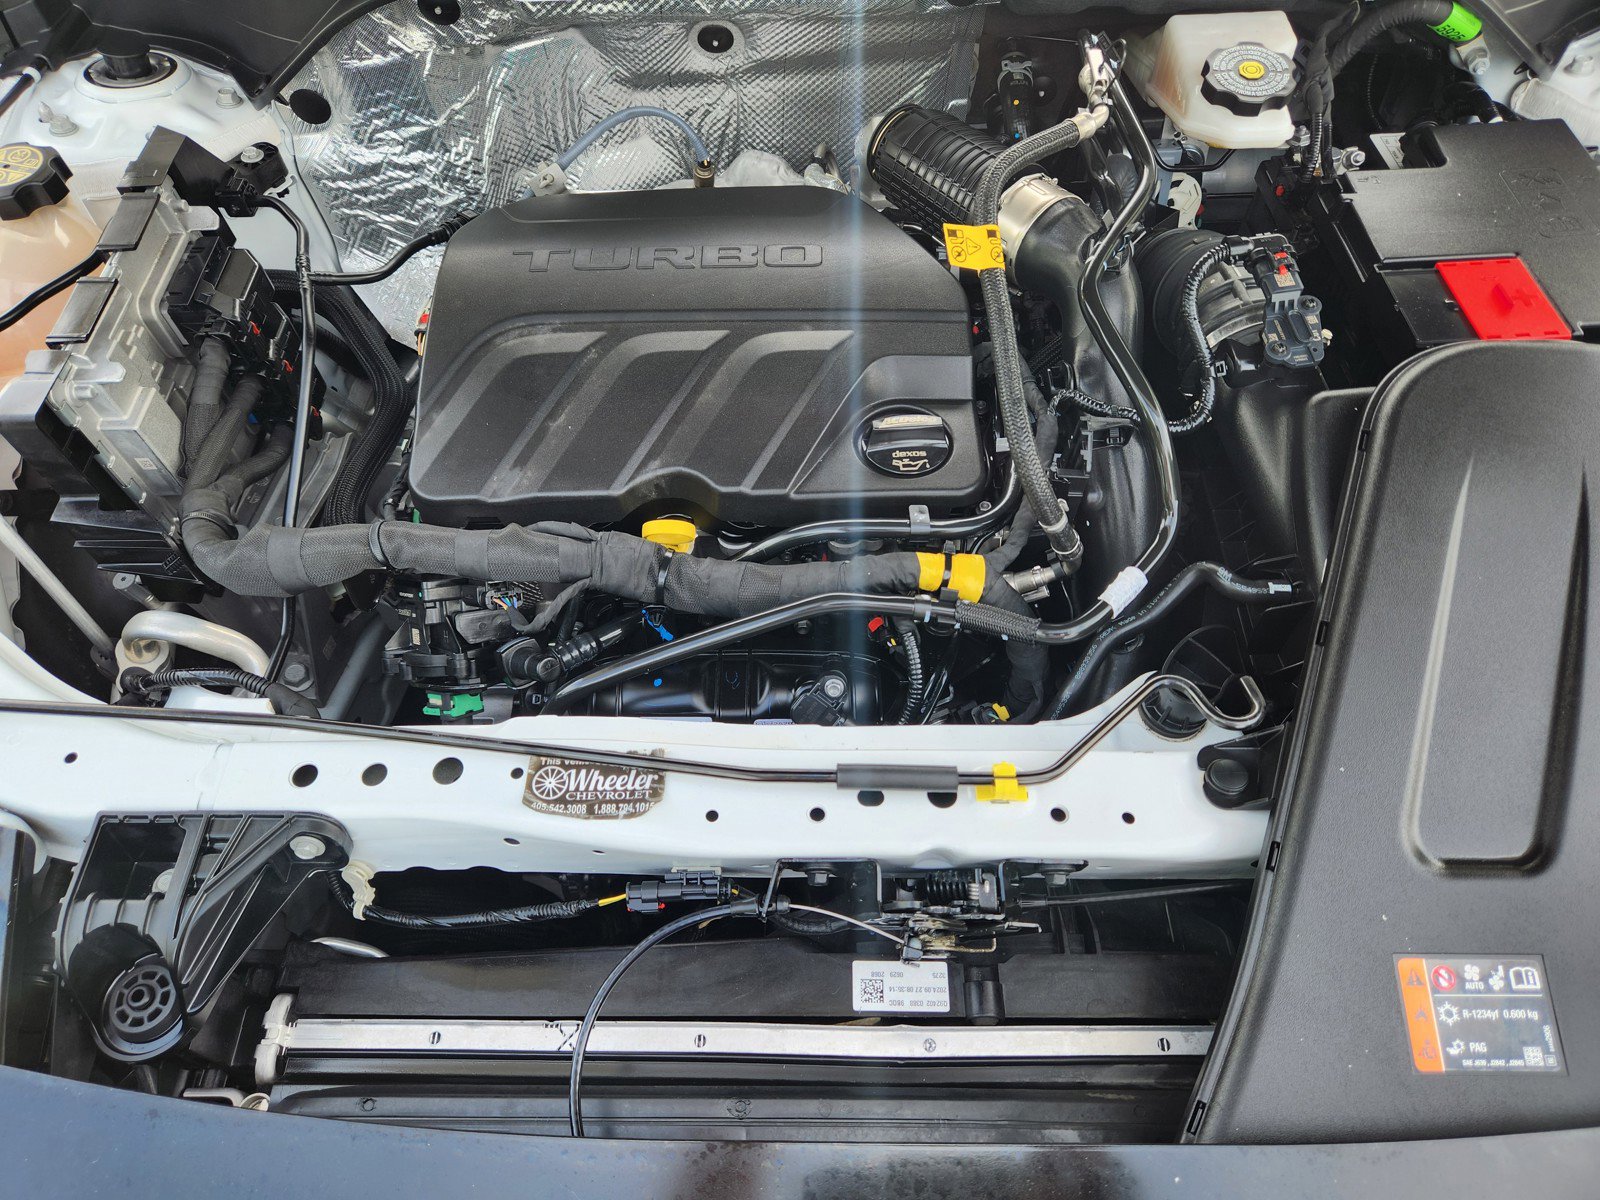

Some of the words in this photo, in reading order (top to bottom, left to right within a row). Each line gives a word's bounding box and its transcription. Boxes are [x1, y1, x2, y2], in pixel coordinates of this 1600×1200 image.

[512, 244, 823, 272] TURBO
[892, 450, 927, 458] dexos
[1118, 614, 1136, 626] Made
[540, 757, 561, 766] This
[564, 768, 659, 791] Wheeler
[566, 790, 652, 800] CHEVROLET
[1462, 1009, 1499, 1020] R-1234yf
[1503, 1009, 1526, 1018] 0.600
[1527, 1009, 1539, 1021] kg
[1469, 1042, 1487, 1053] PAG
